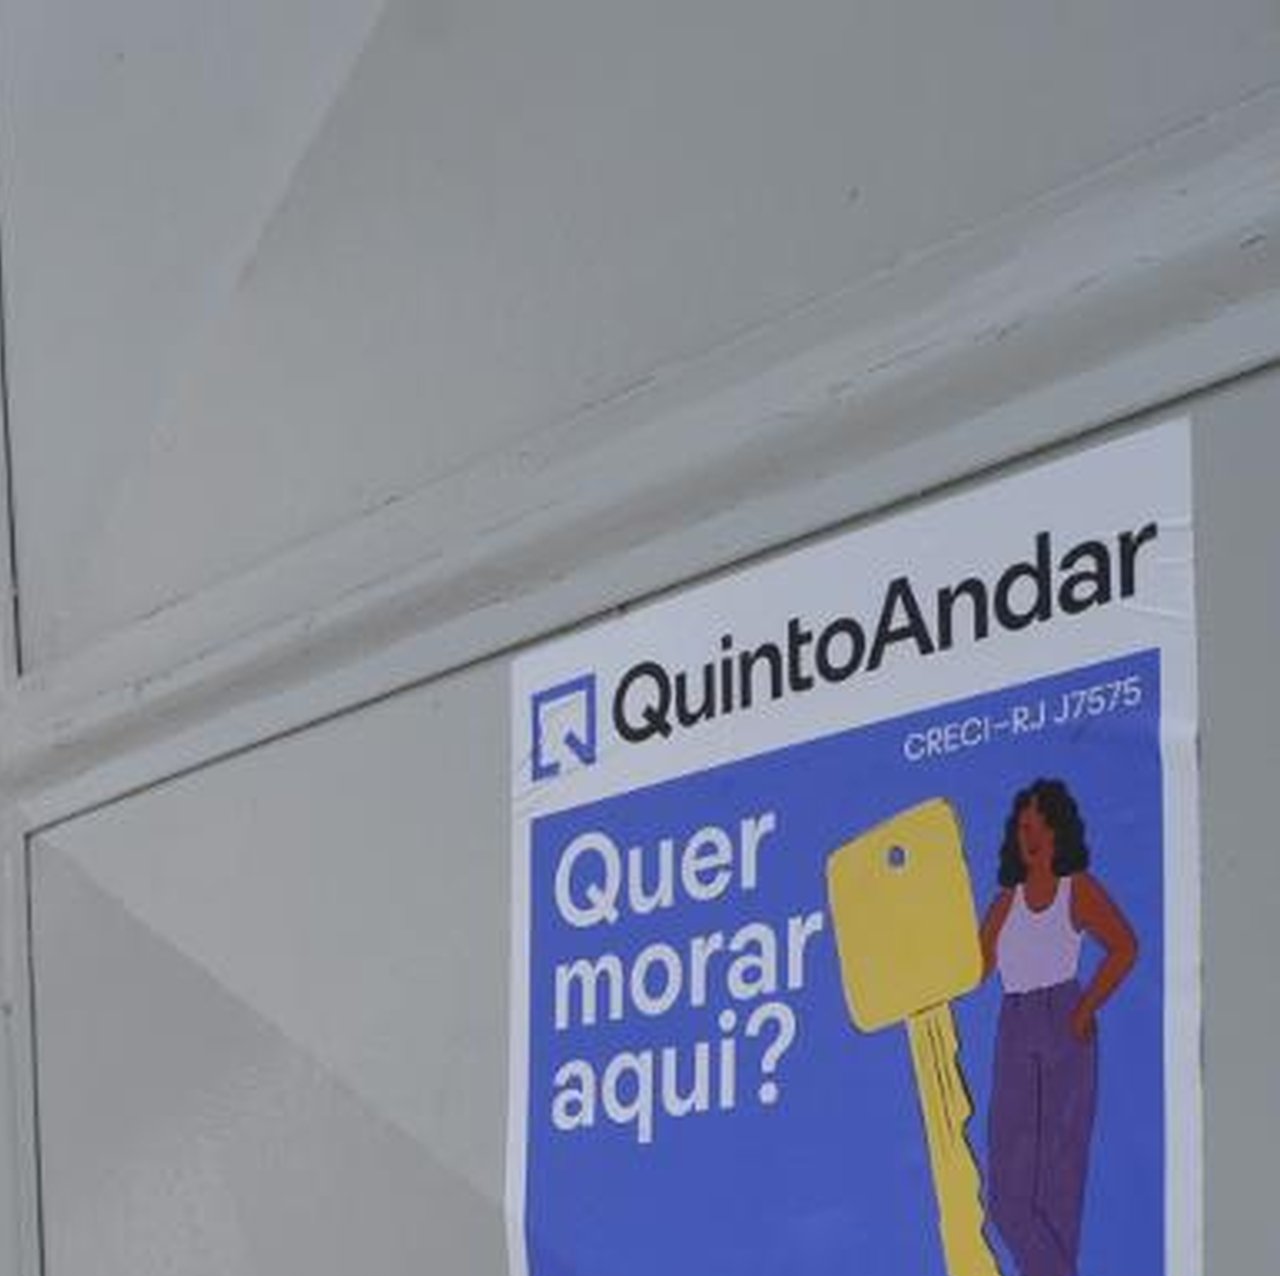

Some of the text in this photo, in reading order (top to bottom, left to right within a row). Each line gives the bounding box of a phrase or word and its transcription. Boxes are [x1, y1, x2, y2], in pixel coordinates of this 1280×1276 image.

[612, 522, 1158, 745] QuintoAndar
[1053, 676, 1142, 729] J7575
[554, 811, 776, 930] Quer
[553, 910, 824, 1030] morar
[551, 1002, 798, 1144] aqui?
